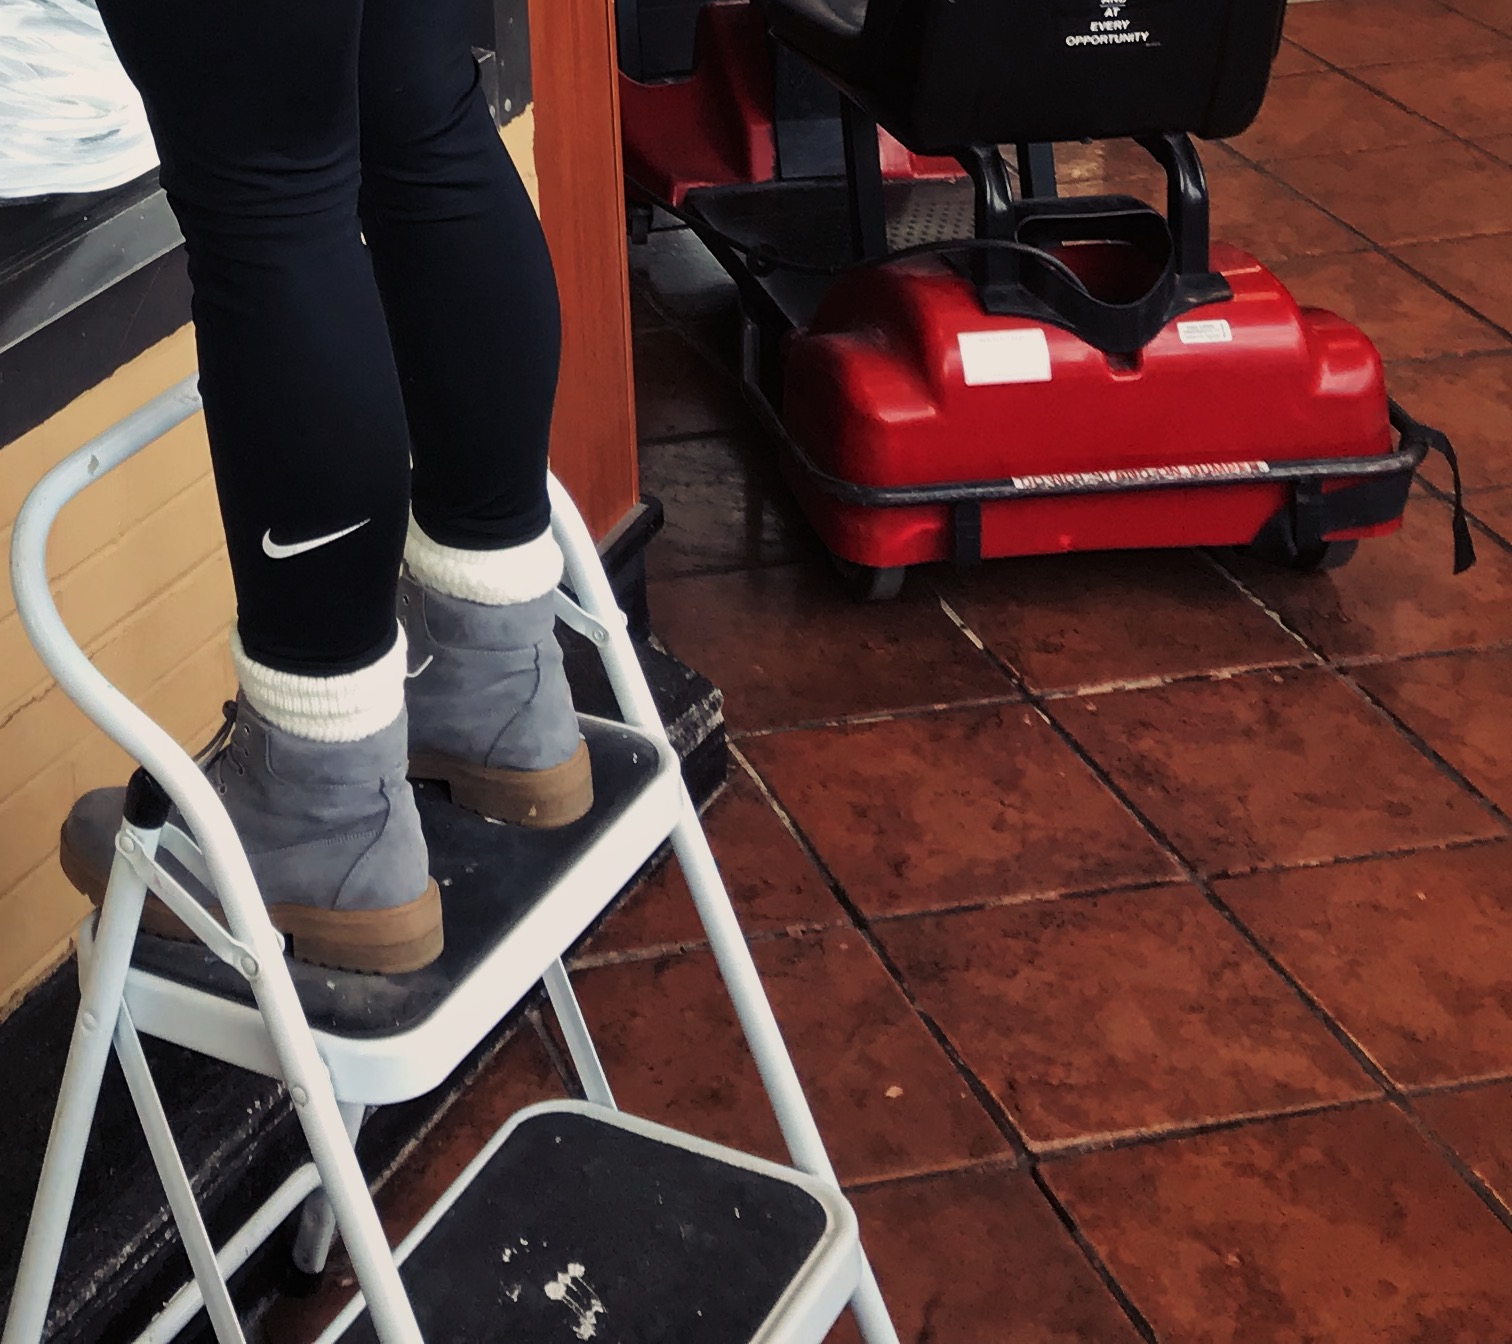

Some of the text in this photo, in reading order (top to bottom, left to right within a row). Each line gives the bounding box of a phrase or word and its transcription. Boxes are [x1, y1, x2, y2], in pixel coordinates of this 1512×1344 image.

[1104, 7, 1121, 17] AT
[1090, 20, 1131, 32] EVERY
[1065, 31, 1150, 47] OPPORTUNITY
